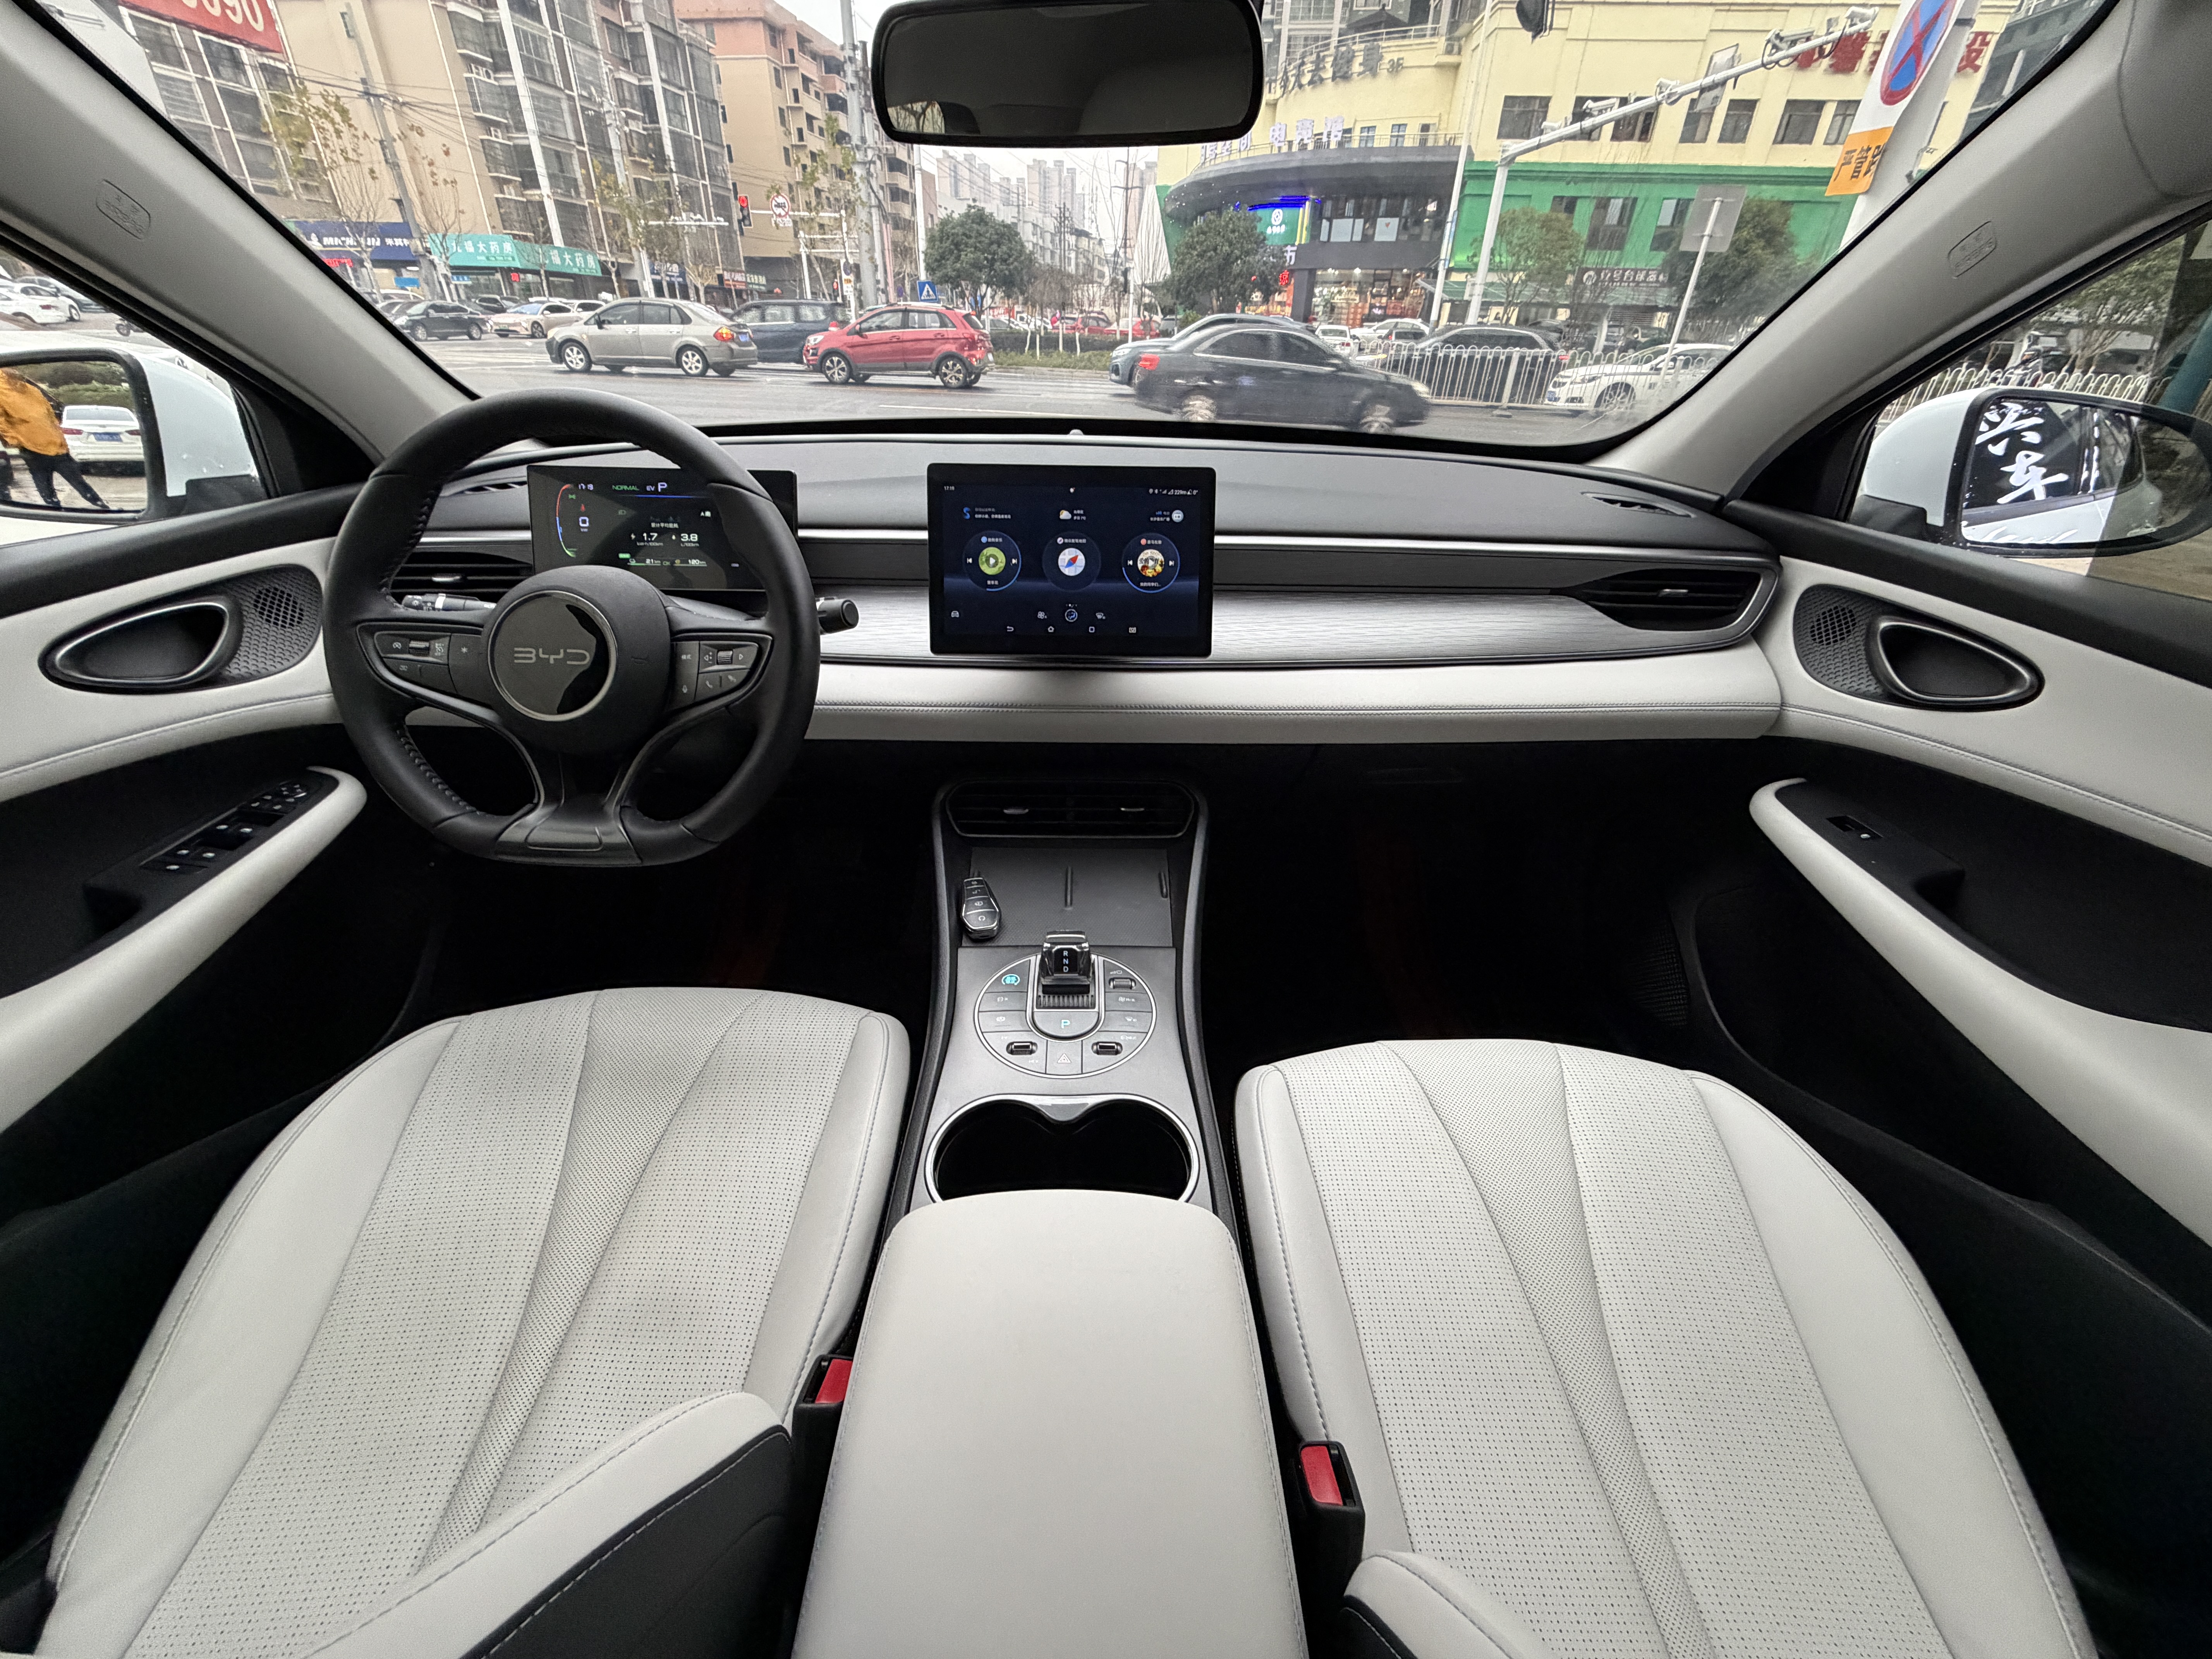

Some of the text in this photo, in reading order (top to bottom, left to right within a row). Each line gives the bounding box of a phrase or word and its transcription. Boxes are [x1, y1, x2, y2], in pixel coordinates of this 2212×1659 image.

[658, 482, 667, 492] P
[579, 517, 589, 527] 0
[643, 532, 698, 541] 1.7 3.8
[514, 647, 591, 664] BYD
[1061, 1019, 1071, 1029] P
